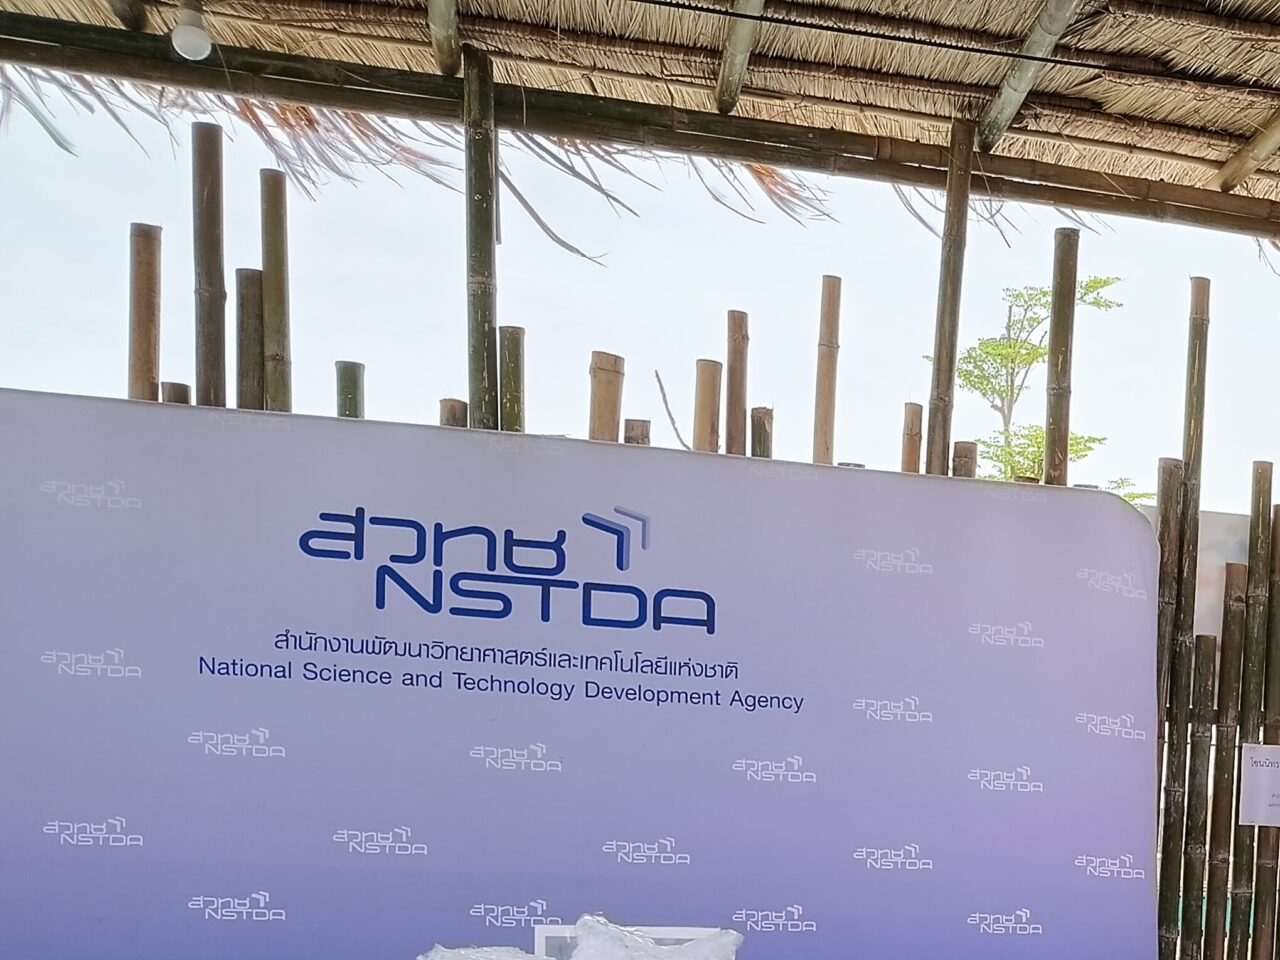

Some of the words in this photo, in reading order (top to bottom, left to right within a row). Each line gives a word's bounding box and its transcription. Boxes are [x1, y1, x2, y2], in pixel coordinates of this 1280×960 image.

[375, 564, 716, 635] NSTDA
[982, 633, 1044, 648] NSTDA
[274, 628, 739, 680] สำนักงานพัฒนาวิทยาศาสตร์และเทคโนโลยีแห่งชาติ
[59, 663, 141, 678] NSTDA
[199, 656, 292, 680] National
[302, 662, 392, 685] Science
[402, 670, 443, 689] and
[452, 672, 575, 701] Technology
[585, 680, 721, 706] Development
[729, 689, 804, 714] Agency
[867, 710, 932, 722] NSTDA
[1088, 724, 1146, 740] NSTDA
[205, 744, 285, 758] NSTDA
[486, 758, 561, 772] NSTDA
[747, 770, 816, 782] NSTDA
[981, 780, 1043, 792] NSTDA
[61, 833, 143, 846] NSTDA
[350, 842, 427, 856] NSTDA
[618, 852, 690, 864] NSTDA
[867, 858, 933, 869] NSTDA
[1087, 866, 1145, 879] NSTDA
[205, 908, 285, 920] NSTDA
[747, 921, 816, 932] NSTDA
[980, 923, 1042, 934] NSTDA
